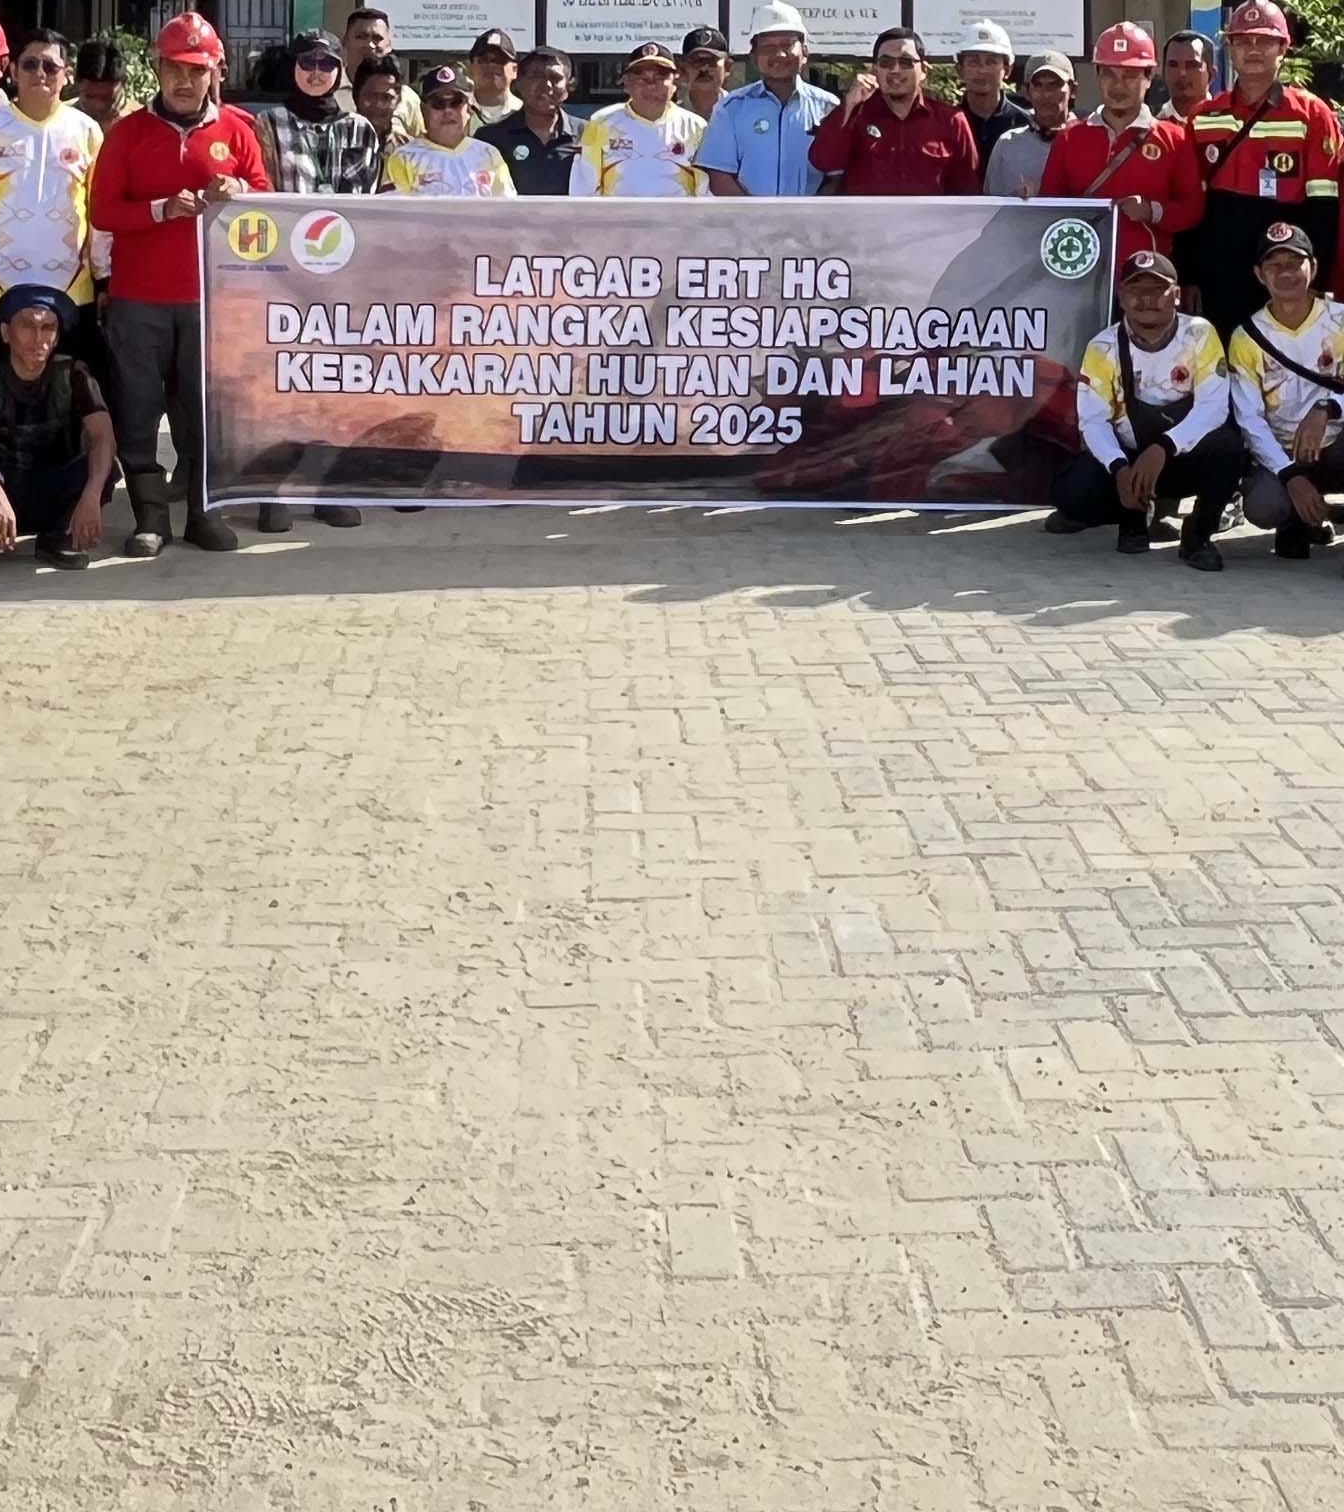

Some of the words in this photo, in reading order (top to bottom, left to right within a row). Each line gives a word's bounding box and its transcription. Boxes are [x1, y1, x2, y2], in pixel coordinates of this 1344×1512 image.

[475, 255, 661, 298] LATGAB
[678, 257, 769, 299] ERT
[782, 258, 852, 300] HG
[266, 304, 434, 347] DALAM
[451, 304, 652, 348] RANGKA
[665, 306, 1047, 351] KESIAPSIAGAAN
[274, 352, 572, 395] KEBAKARAN
[587, 353, 752, 397] HUTAN
[766, 356, 862, 397] DAN
[878, 356, 1036, 398] LAHAN
[512, 404, 676, 445] TAHUN
[690, 403, 803, 446] 2025
